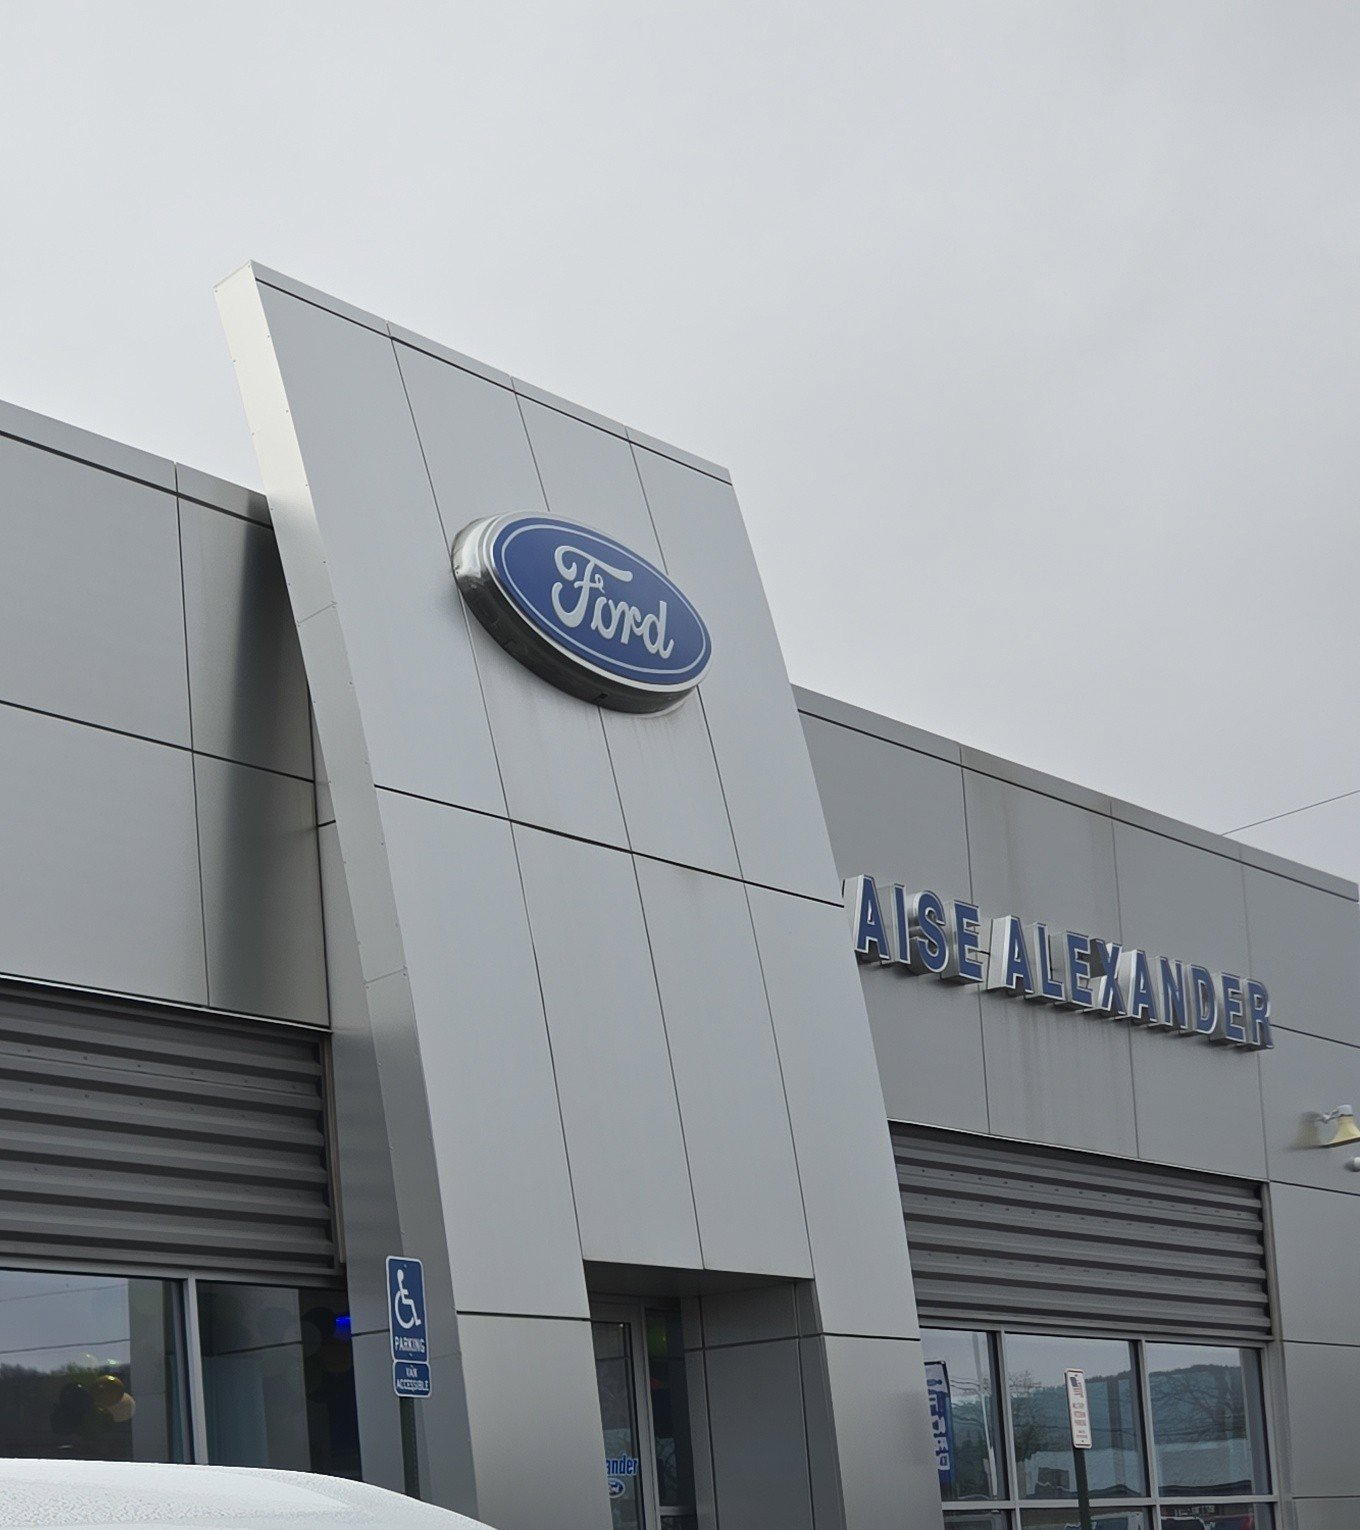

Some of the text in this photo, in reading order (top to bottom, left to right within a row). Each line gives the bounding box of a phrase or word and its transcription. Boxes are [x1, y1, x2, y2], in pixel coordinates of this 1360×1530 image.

[551, 545, 675, 659] Ford
[988, 914, 1274, 1050] ALEXANDER
[394, 1336, 425, 1353] PARKING
[405, 1367, 418, 1378] VAN
[396, 1379, 429, 1391] ACCESSIBLE
